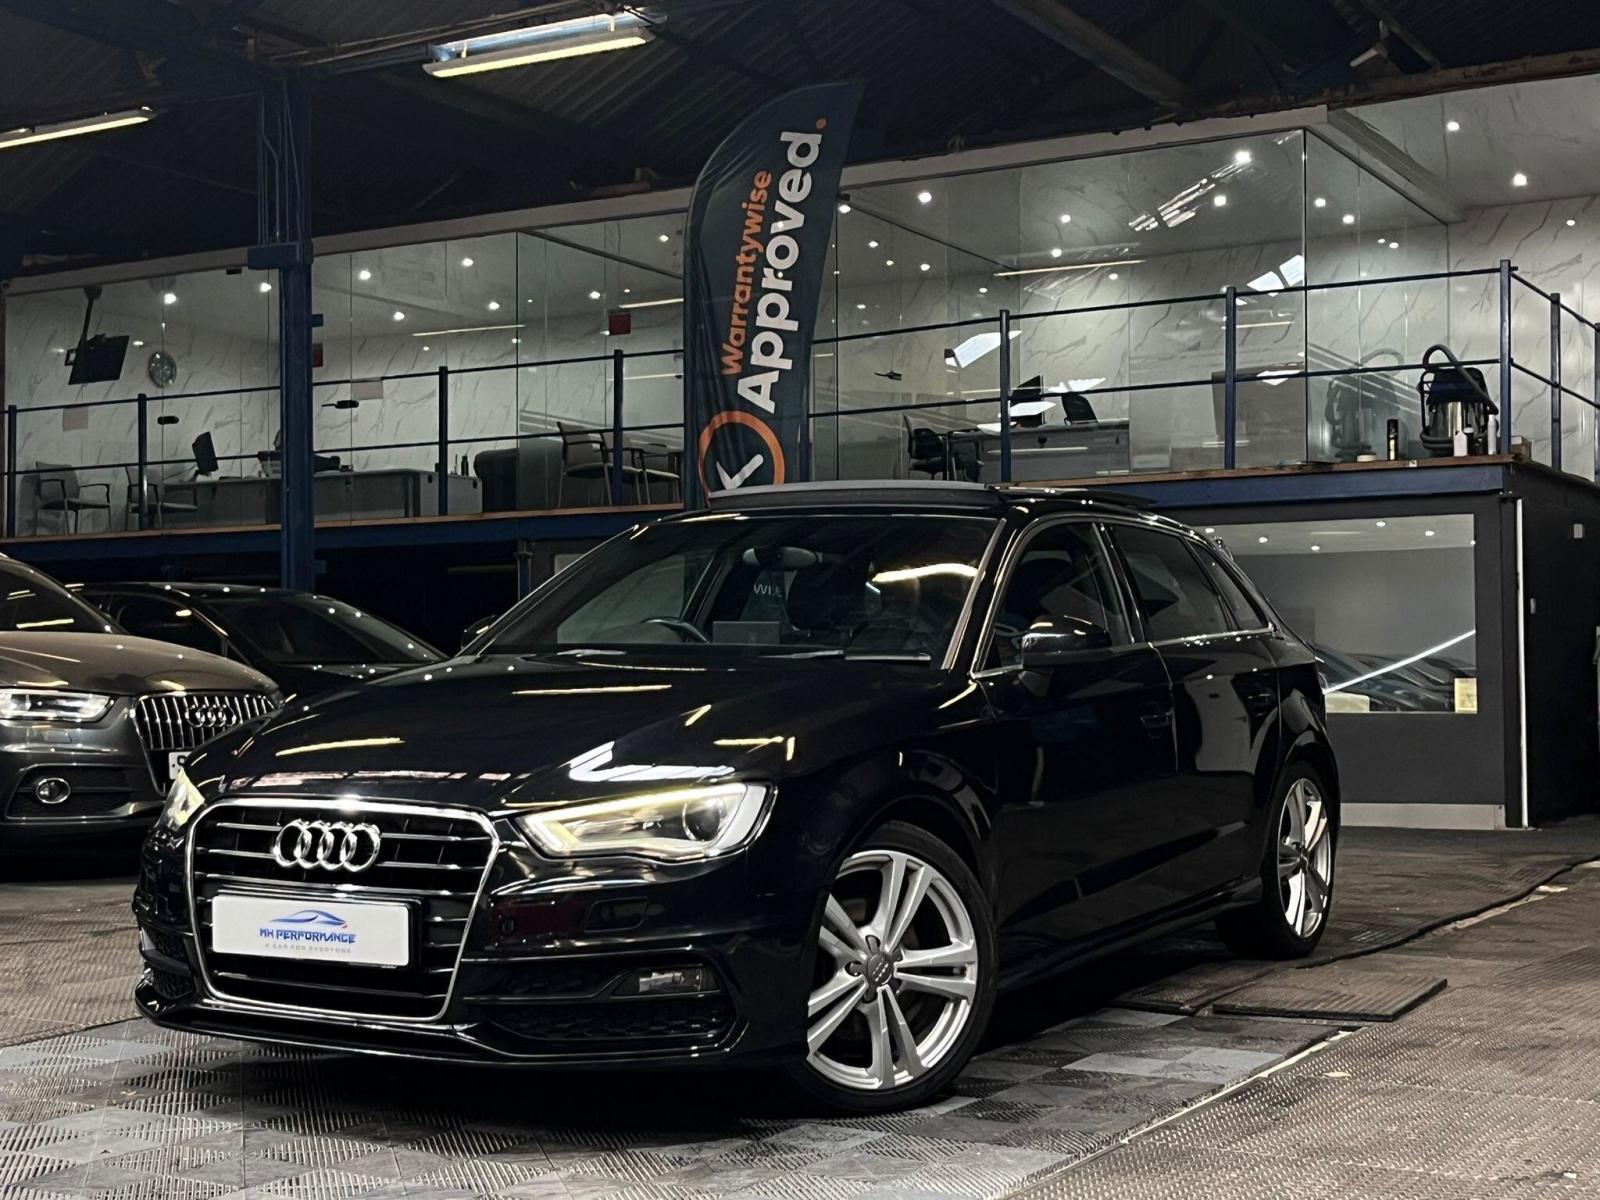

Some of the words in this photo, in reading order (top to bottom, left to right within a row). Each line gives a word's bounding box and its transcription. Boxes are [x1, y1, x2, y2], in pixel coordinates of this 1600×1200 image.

[721, 170, 773, 376] Warrantywise
[737, 117, 828, 415] Approved.
[276, 929, 356, 944] PERFORMANCE
